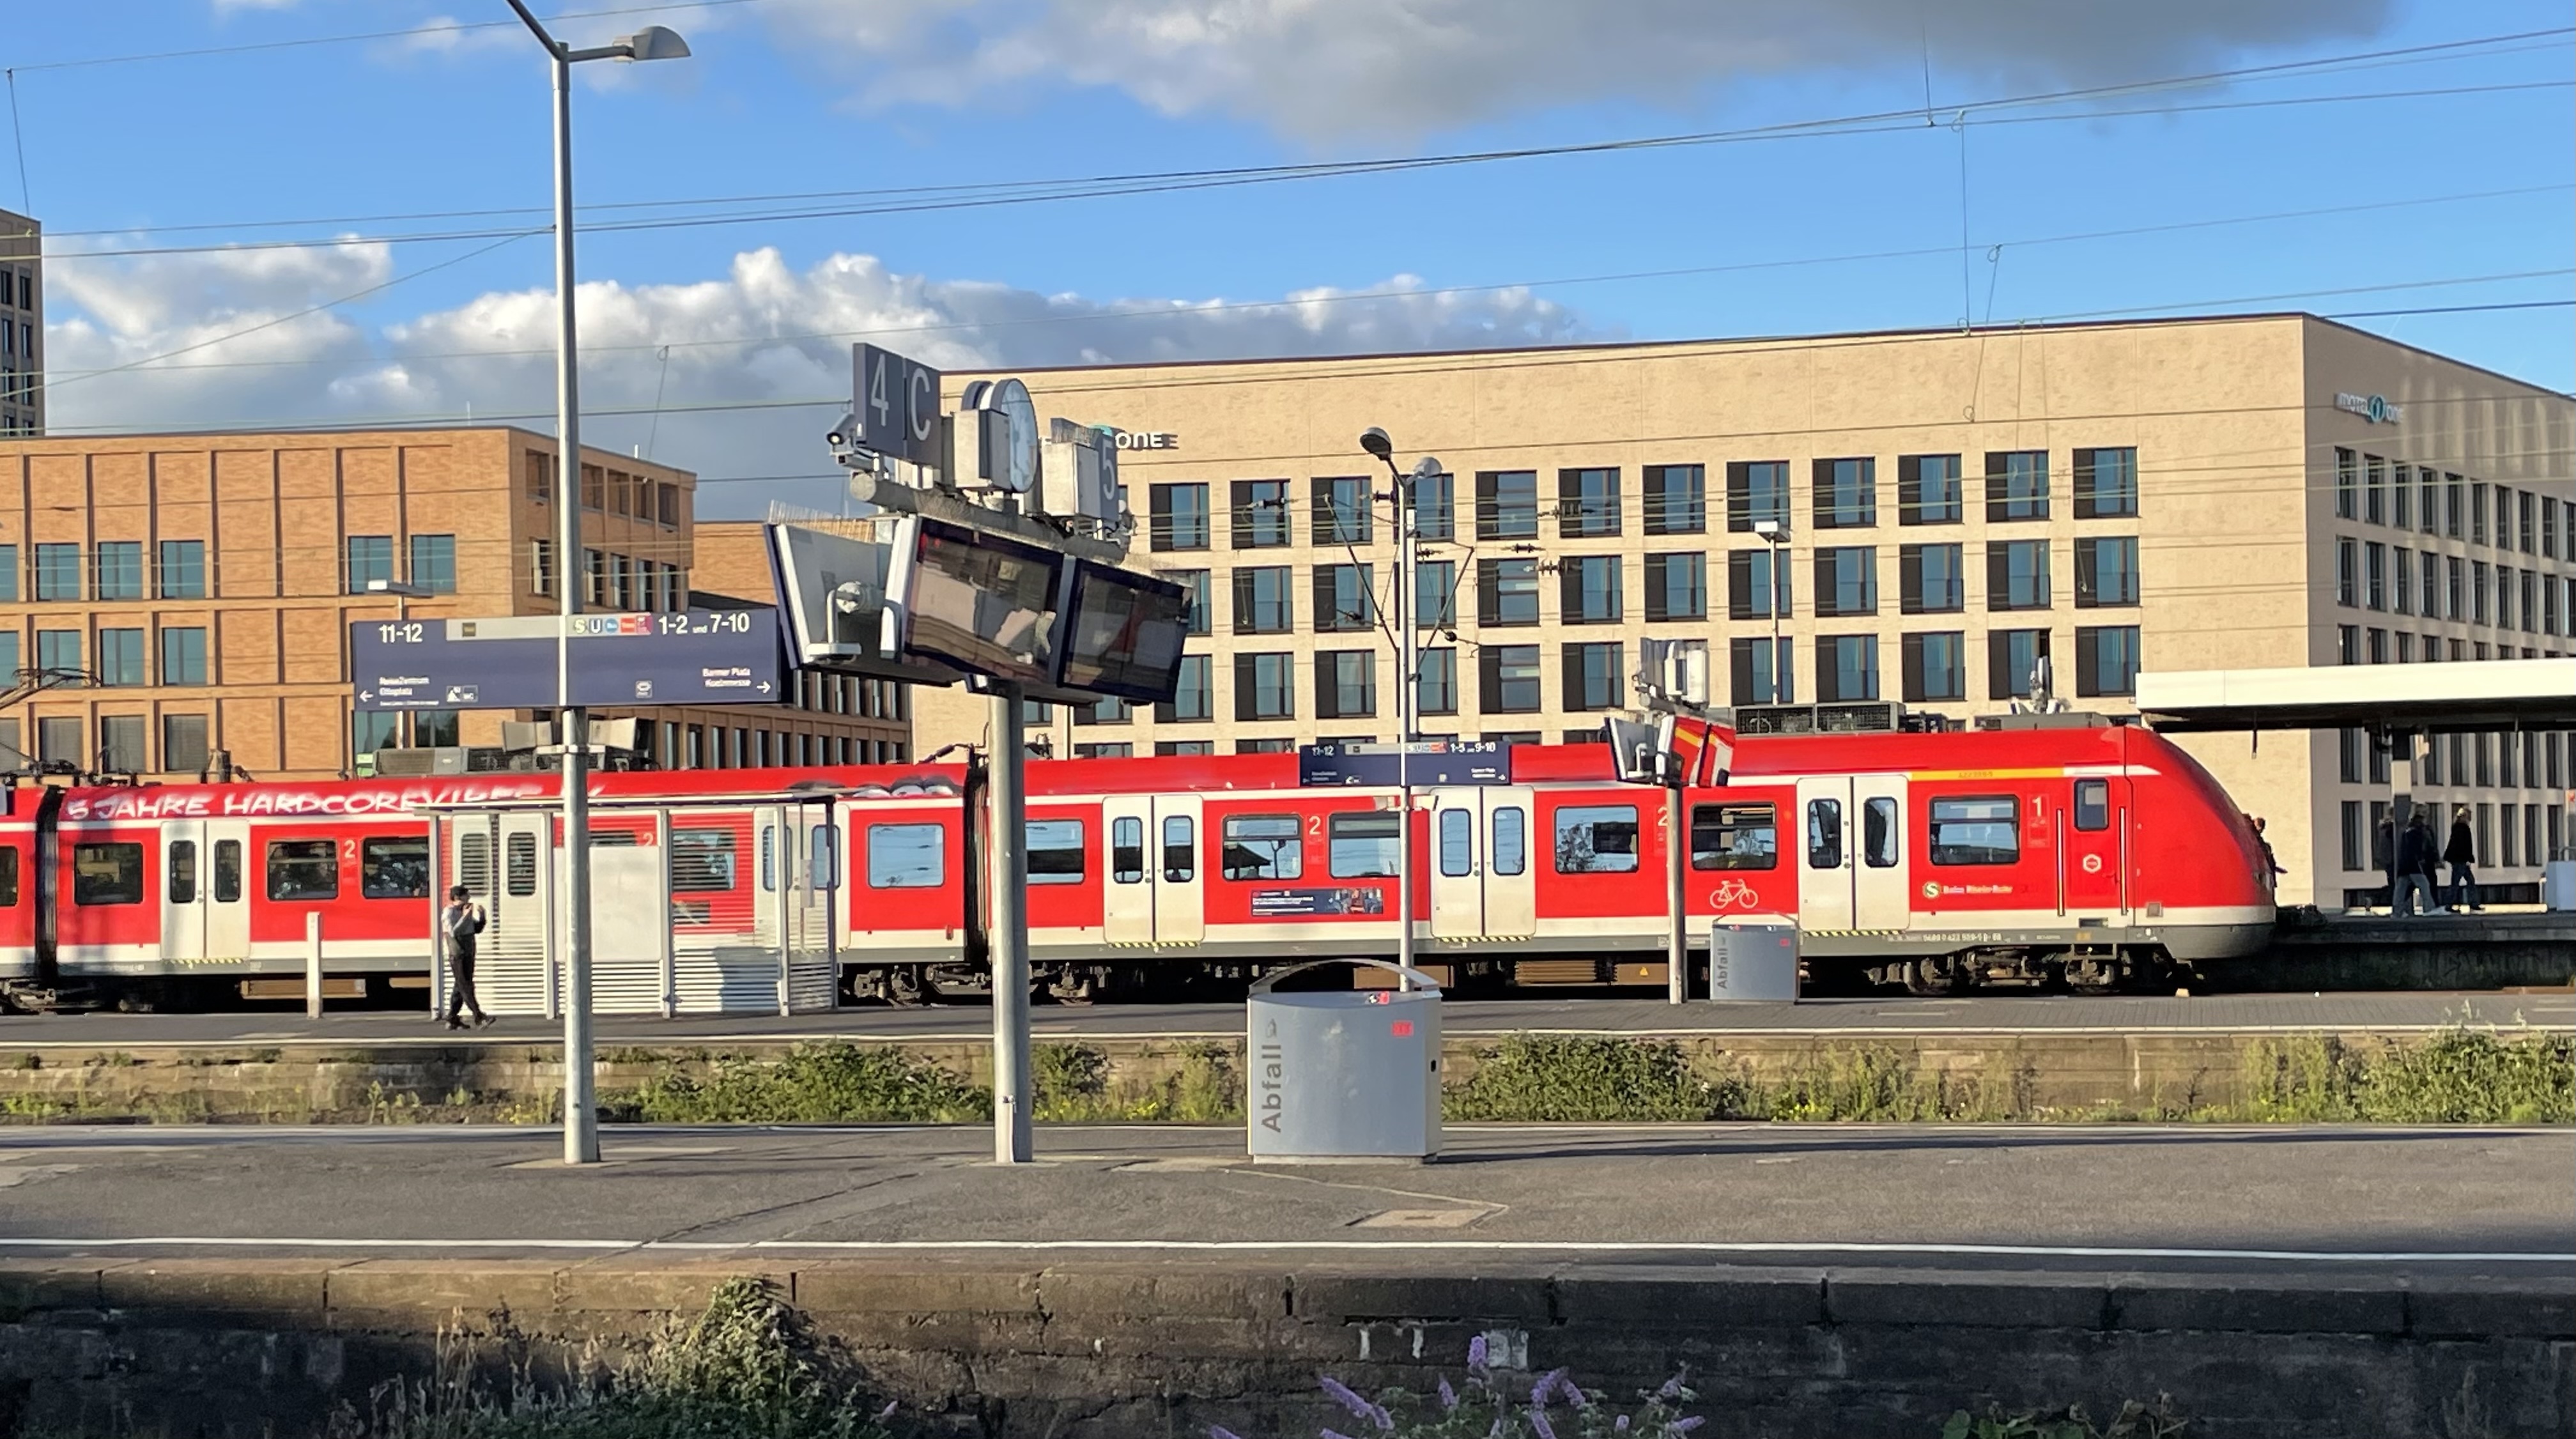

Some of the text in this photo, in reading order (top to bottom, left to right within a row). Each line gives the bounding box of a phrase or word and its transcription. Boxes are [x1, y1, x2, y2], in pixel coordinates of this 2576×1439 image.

[870, 353, 931, 441] 4 C
[1102, 438, 1115, 500] 5
[379, 623, 423, 643] 11-12
[658, 615, 688, 635] 1-2
[709, 612, 750, 633] 7-10
[68, 799, 88, 820] 5
[95, 792, 216, 820] JAHRE
[1657, 806, 1668, 826] 2
[2032, 796, 2042, 817] 1
[1309, 815, 1322, 835] 2
[344, 839, 356, 858] 2
[1717, 948, 1728, 989] Abfall
[1261, 1045, 1281, 1133] Abfall
